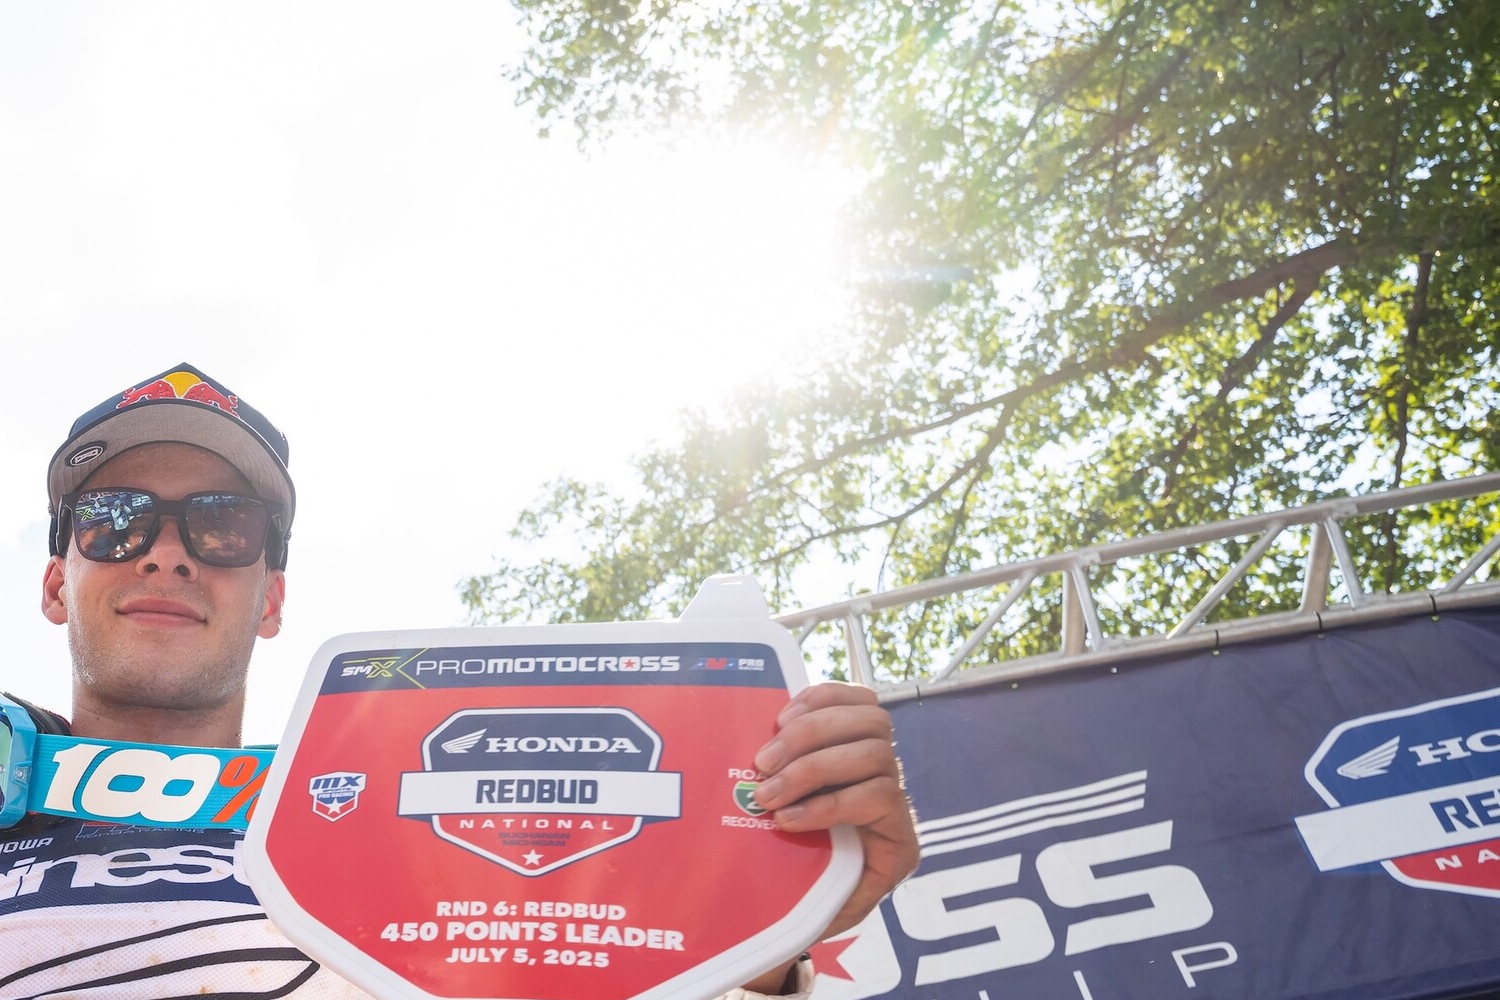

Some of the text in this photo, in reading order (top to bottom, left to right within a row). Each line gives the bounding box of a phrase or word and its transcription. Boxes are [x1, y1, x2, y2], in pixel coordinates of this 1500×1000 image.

[341, 660, 397, 679] SMX
[485, 737, 641, 753] HONDA
[728, 768, 766, 780] RO
[312, 775, 363, 790] MX
[475, 779, 598, 804] REDBUD
[460, 818, 614, 830] NATIONAL
[499, 832, 571, 840] BUCHANAN
[502, 839, 566, 847] MICHIGAN
[436, 901, 627, 921] RND 6: REDBUD
[380, 921, 685, 951] 450 POINTS LEADER
[445, 948, 610, 968] JULY 5, 2025
